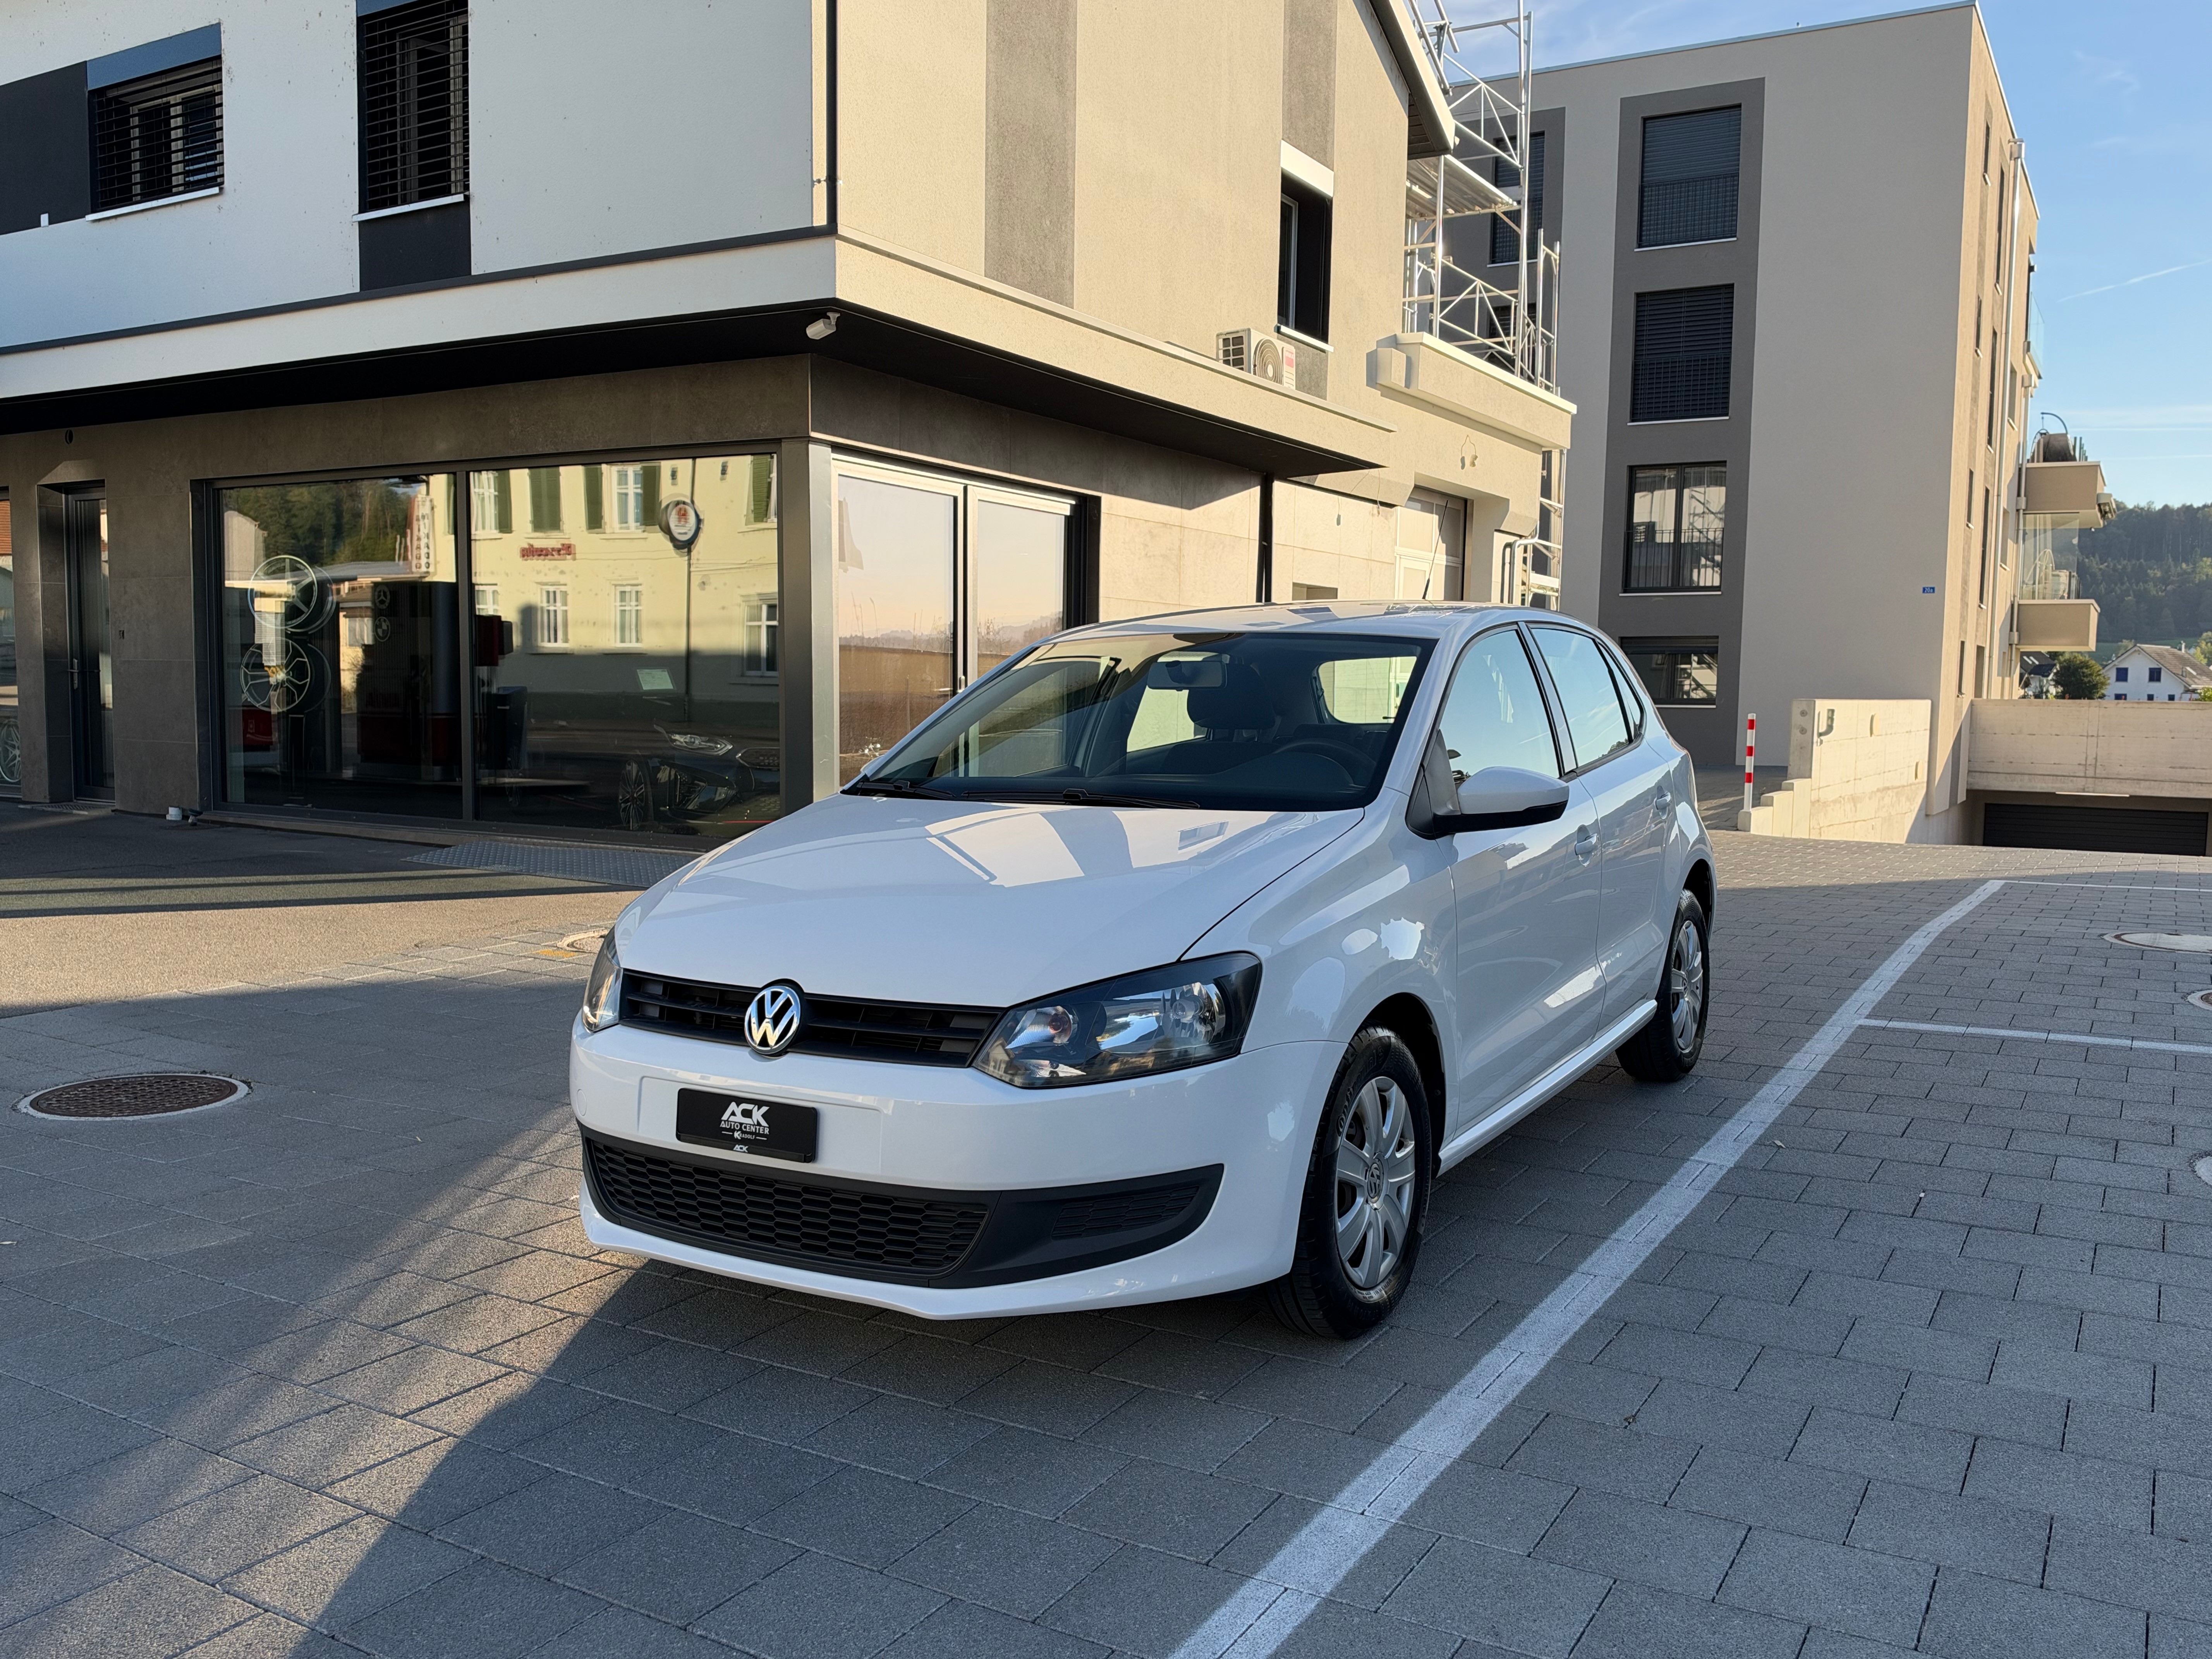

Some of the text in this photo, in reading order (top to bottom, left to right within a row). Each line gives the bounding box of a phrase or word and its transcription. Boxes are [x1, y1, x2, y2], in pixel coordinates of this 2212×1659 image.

[747, 988, 798, 1051] VW
[721, 1101, 770, 1127] ACK
[720, 1120, 769, 1135] AUTO CENTER
[734, 1130, 756, 1139] KRADOLF
[733, 1144, 749, 1152] ACK
